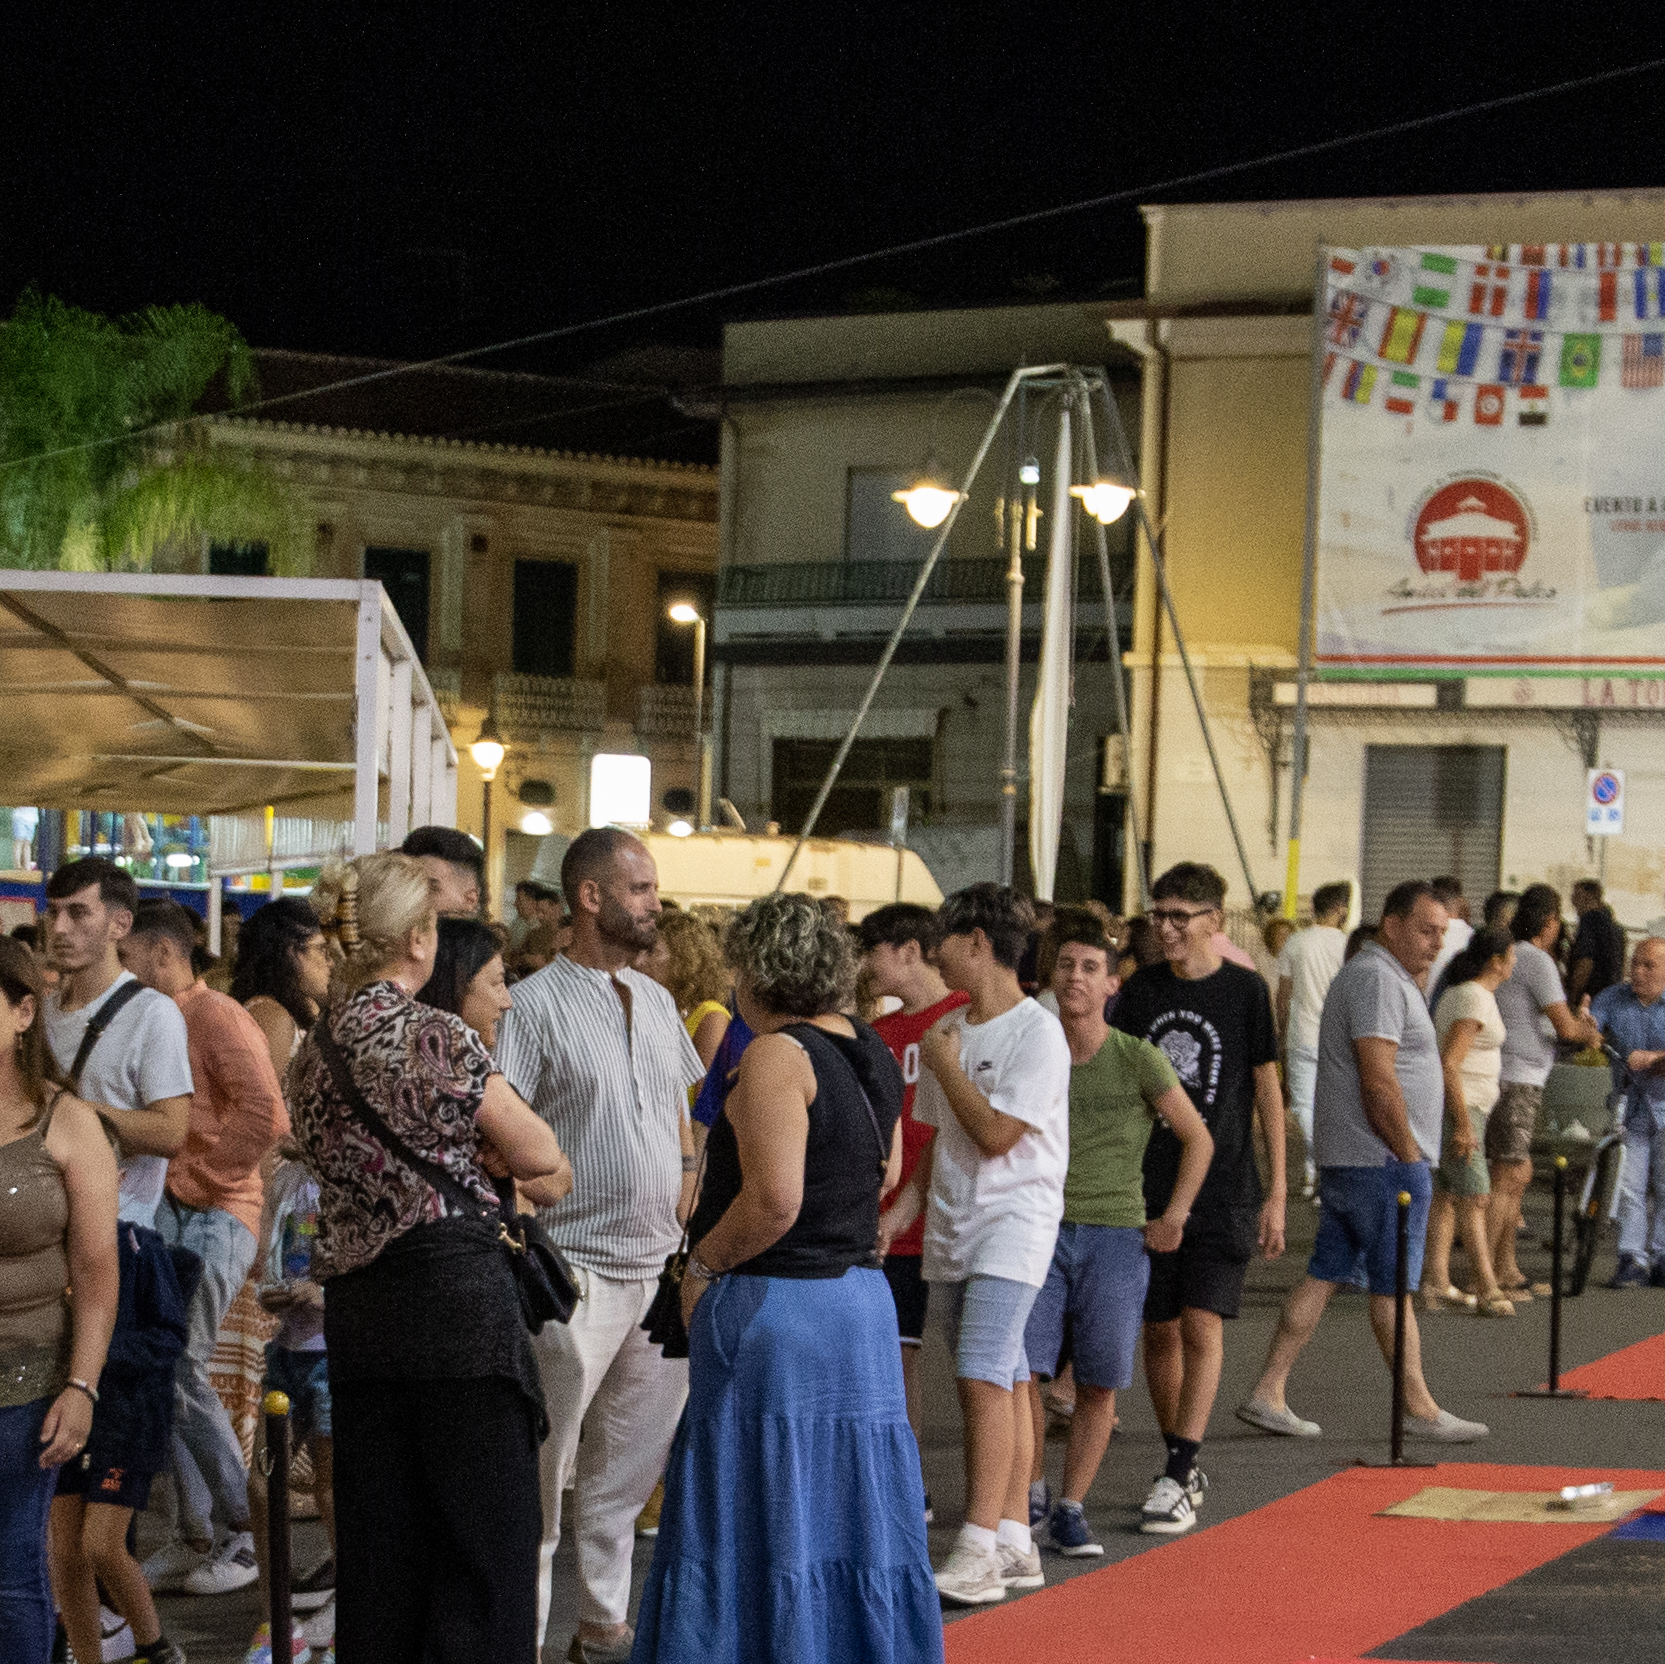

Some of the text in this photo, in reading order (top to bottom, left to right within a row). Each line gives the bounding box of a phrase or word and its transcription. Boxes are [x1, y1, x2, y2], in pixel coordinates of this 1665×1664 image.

[1582, 679, 1615, 706] LA
[1149, 1010, 1176, 1032] WHEN
[1179, 1010, 1203, 1025] YOU
[1202, 1020, 1222, 1051] WERE
